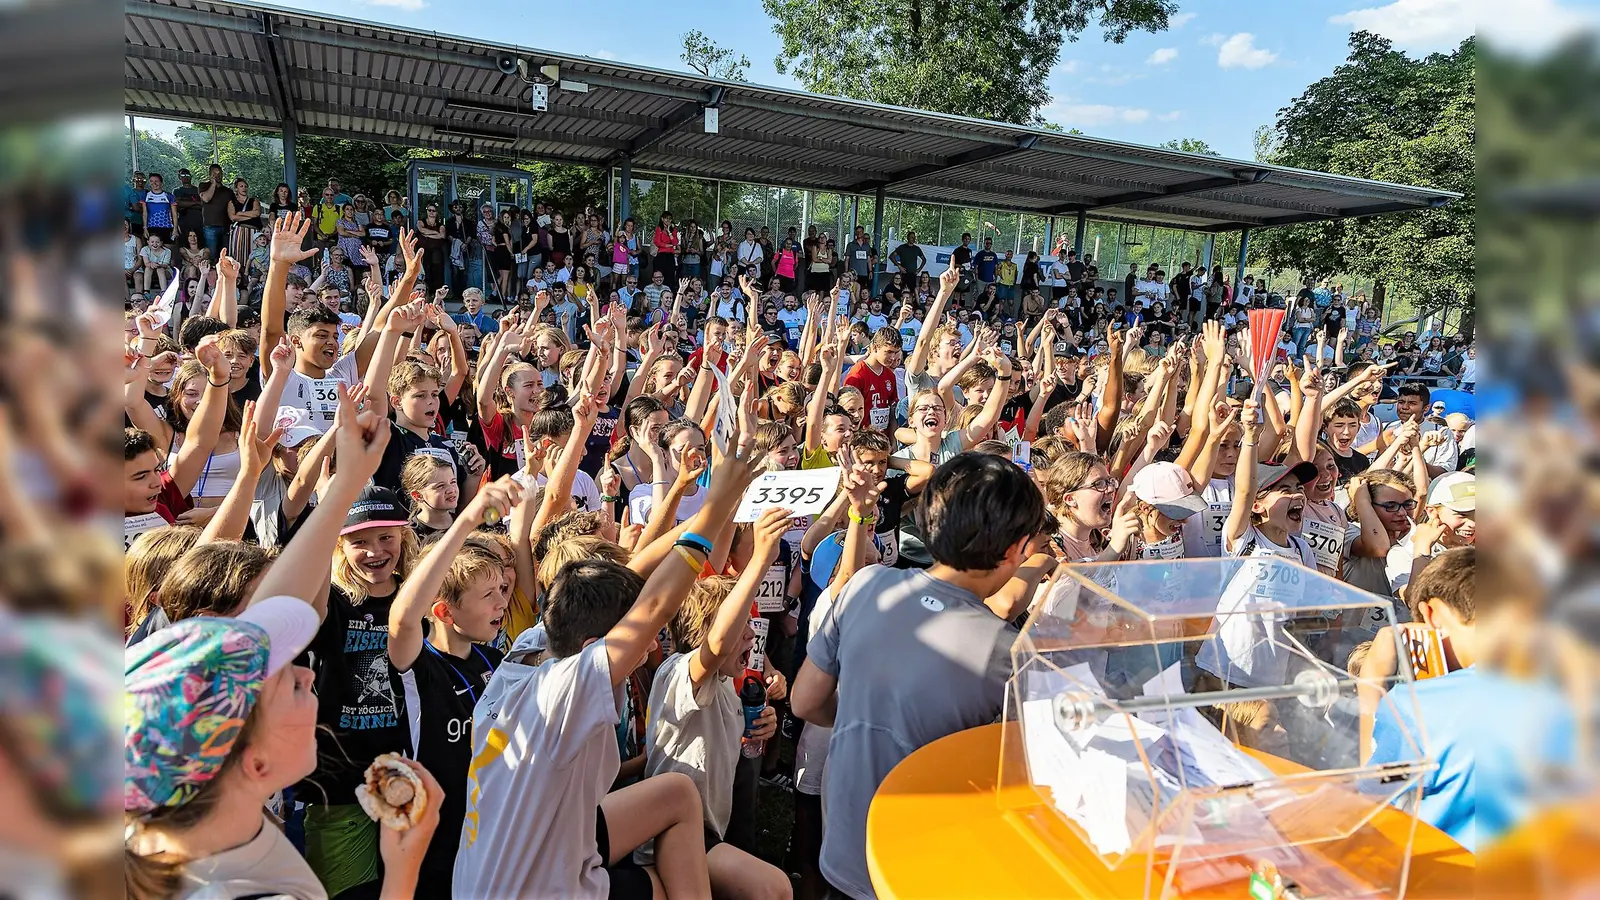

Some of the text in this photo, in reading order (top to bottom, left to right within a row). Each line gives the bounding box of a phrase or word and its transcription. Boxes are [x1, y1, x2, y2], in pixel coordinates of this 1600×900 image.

[752, 487, 824, 505] 3395
[1308, 532, 1343, 556] 3704
[1256, 562, 1300, 585] 3708
[348, 620, 368, 630] EIN
[341, 705, 357, 715] IST
